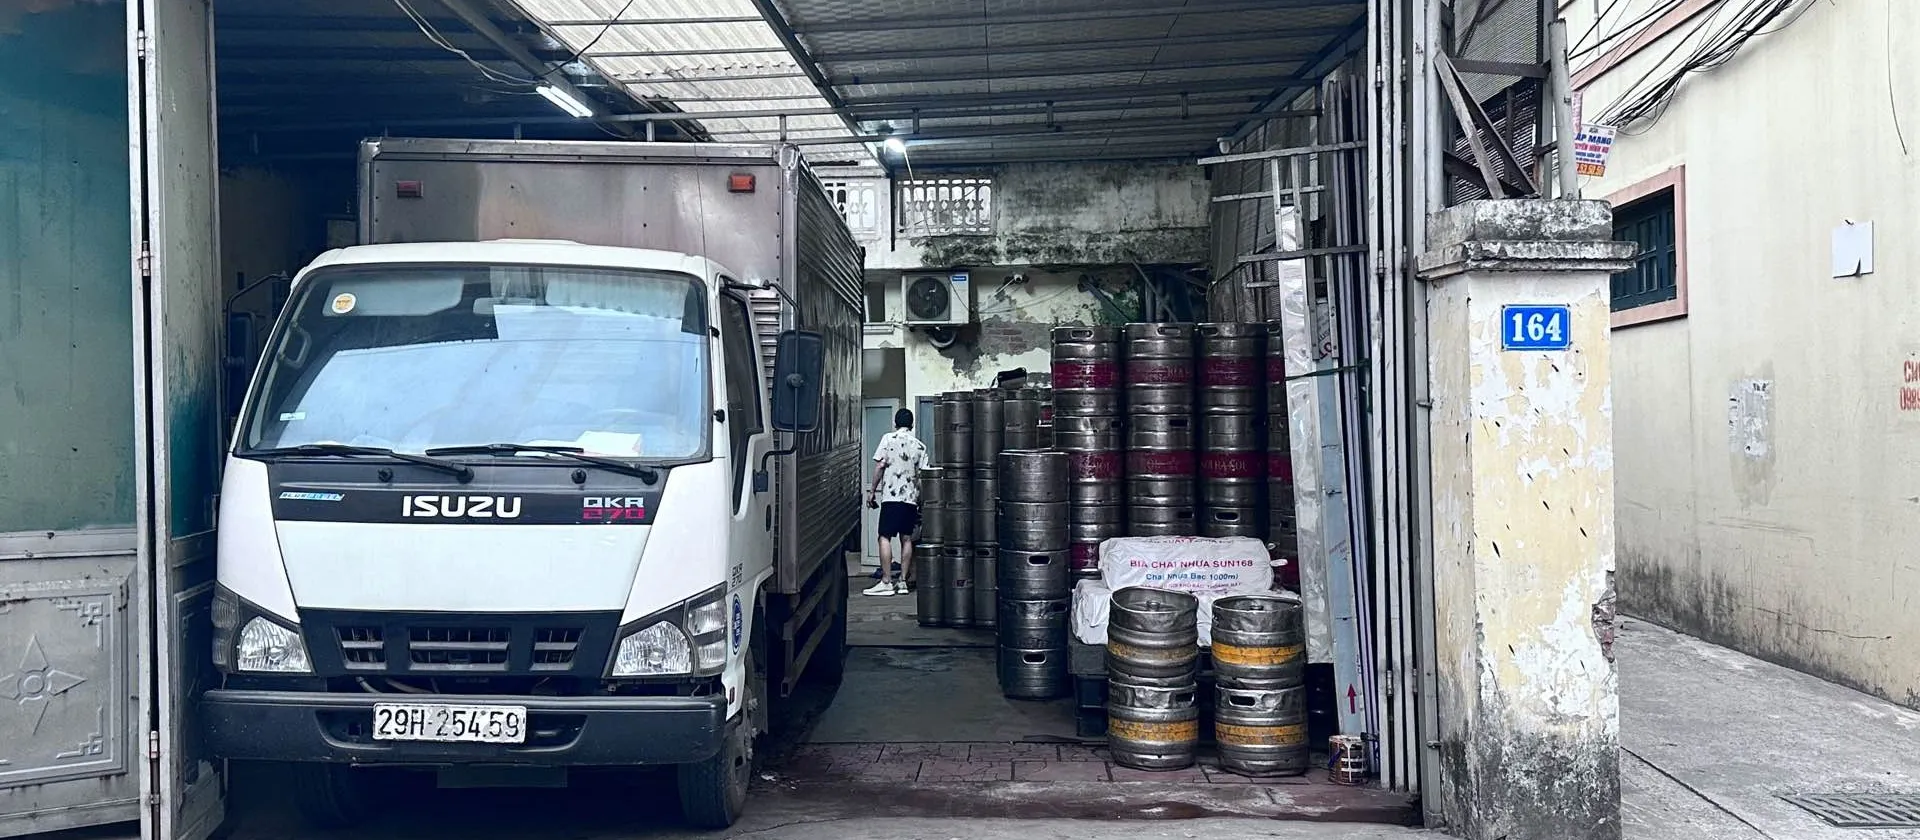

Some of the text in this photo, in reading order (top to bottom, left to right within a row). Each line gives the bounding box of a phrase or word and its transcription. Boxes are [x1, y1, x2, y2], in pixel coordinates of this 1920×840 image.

[1512, 312, 1562, 342] 164
[402, 496, 521, 518] ISUZU
[583, 497, 644, 508] QKR
[583, 508, 644, 519] 270
[1130, 560, 1148, 568] BIA
[1151, 560, 1177, 569] CHAI
[1213, 559, 1253, 568] SUN168
